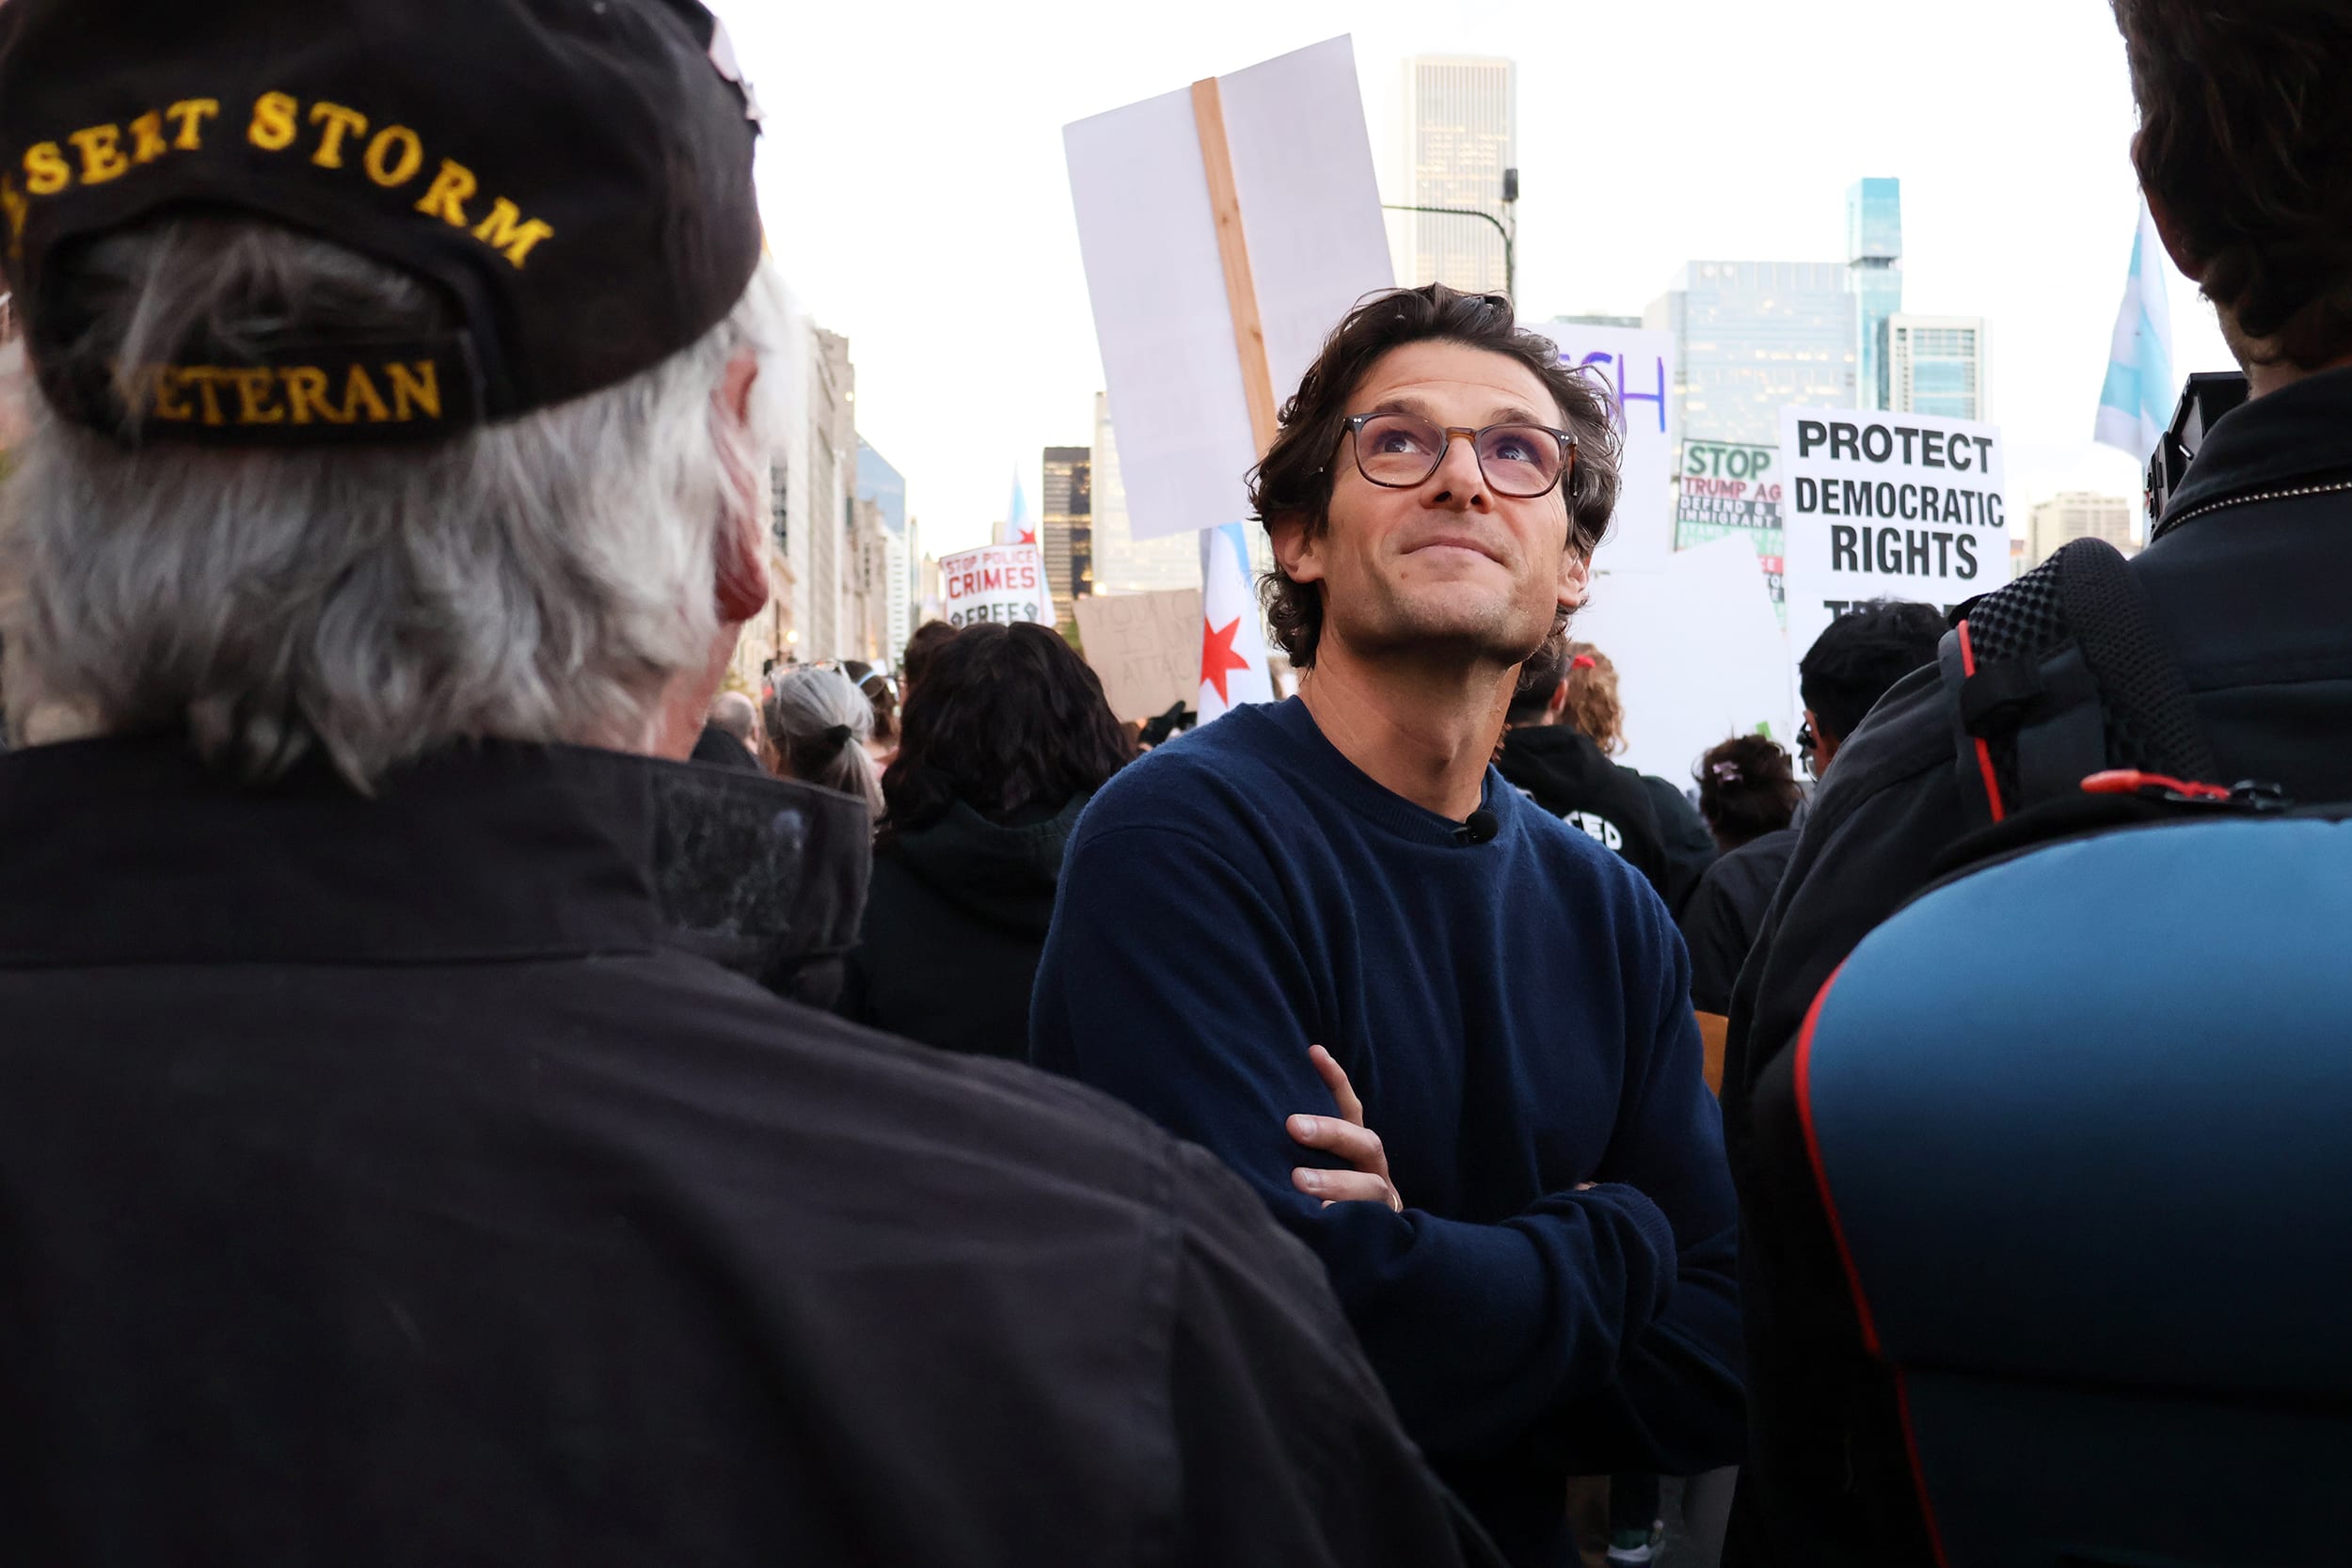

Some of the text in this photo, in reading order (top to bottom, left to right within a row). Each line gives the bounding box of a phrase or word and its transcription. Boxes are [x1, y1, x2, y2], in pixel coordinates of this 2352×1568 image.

[247, 91, 554, 268] STORM
[1798, 420, 1993, 473] PROTECT
[1687, 446, 1771, 481] STOP
[1684, 477, 1746, 499] TRUMP
[1795, 477, 2004, 528] DEMOCRATIC
[1678, 510, 1773, 529] IMMIGRANT
[1680, 497, 1745, 515] DEFEND
[946, 550, 1034, 575] STOP POLICE
[1831, 525, 1978, 579] RIGHTS
[948, 566, 1035, 599] CRIMES
[966, 603, 1019, 625] FREE
